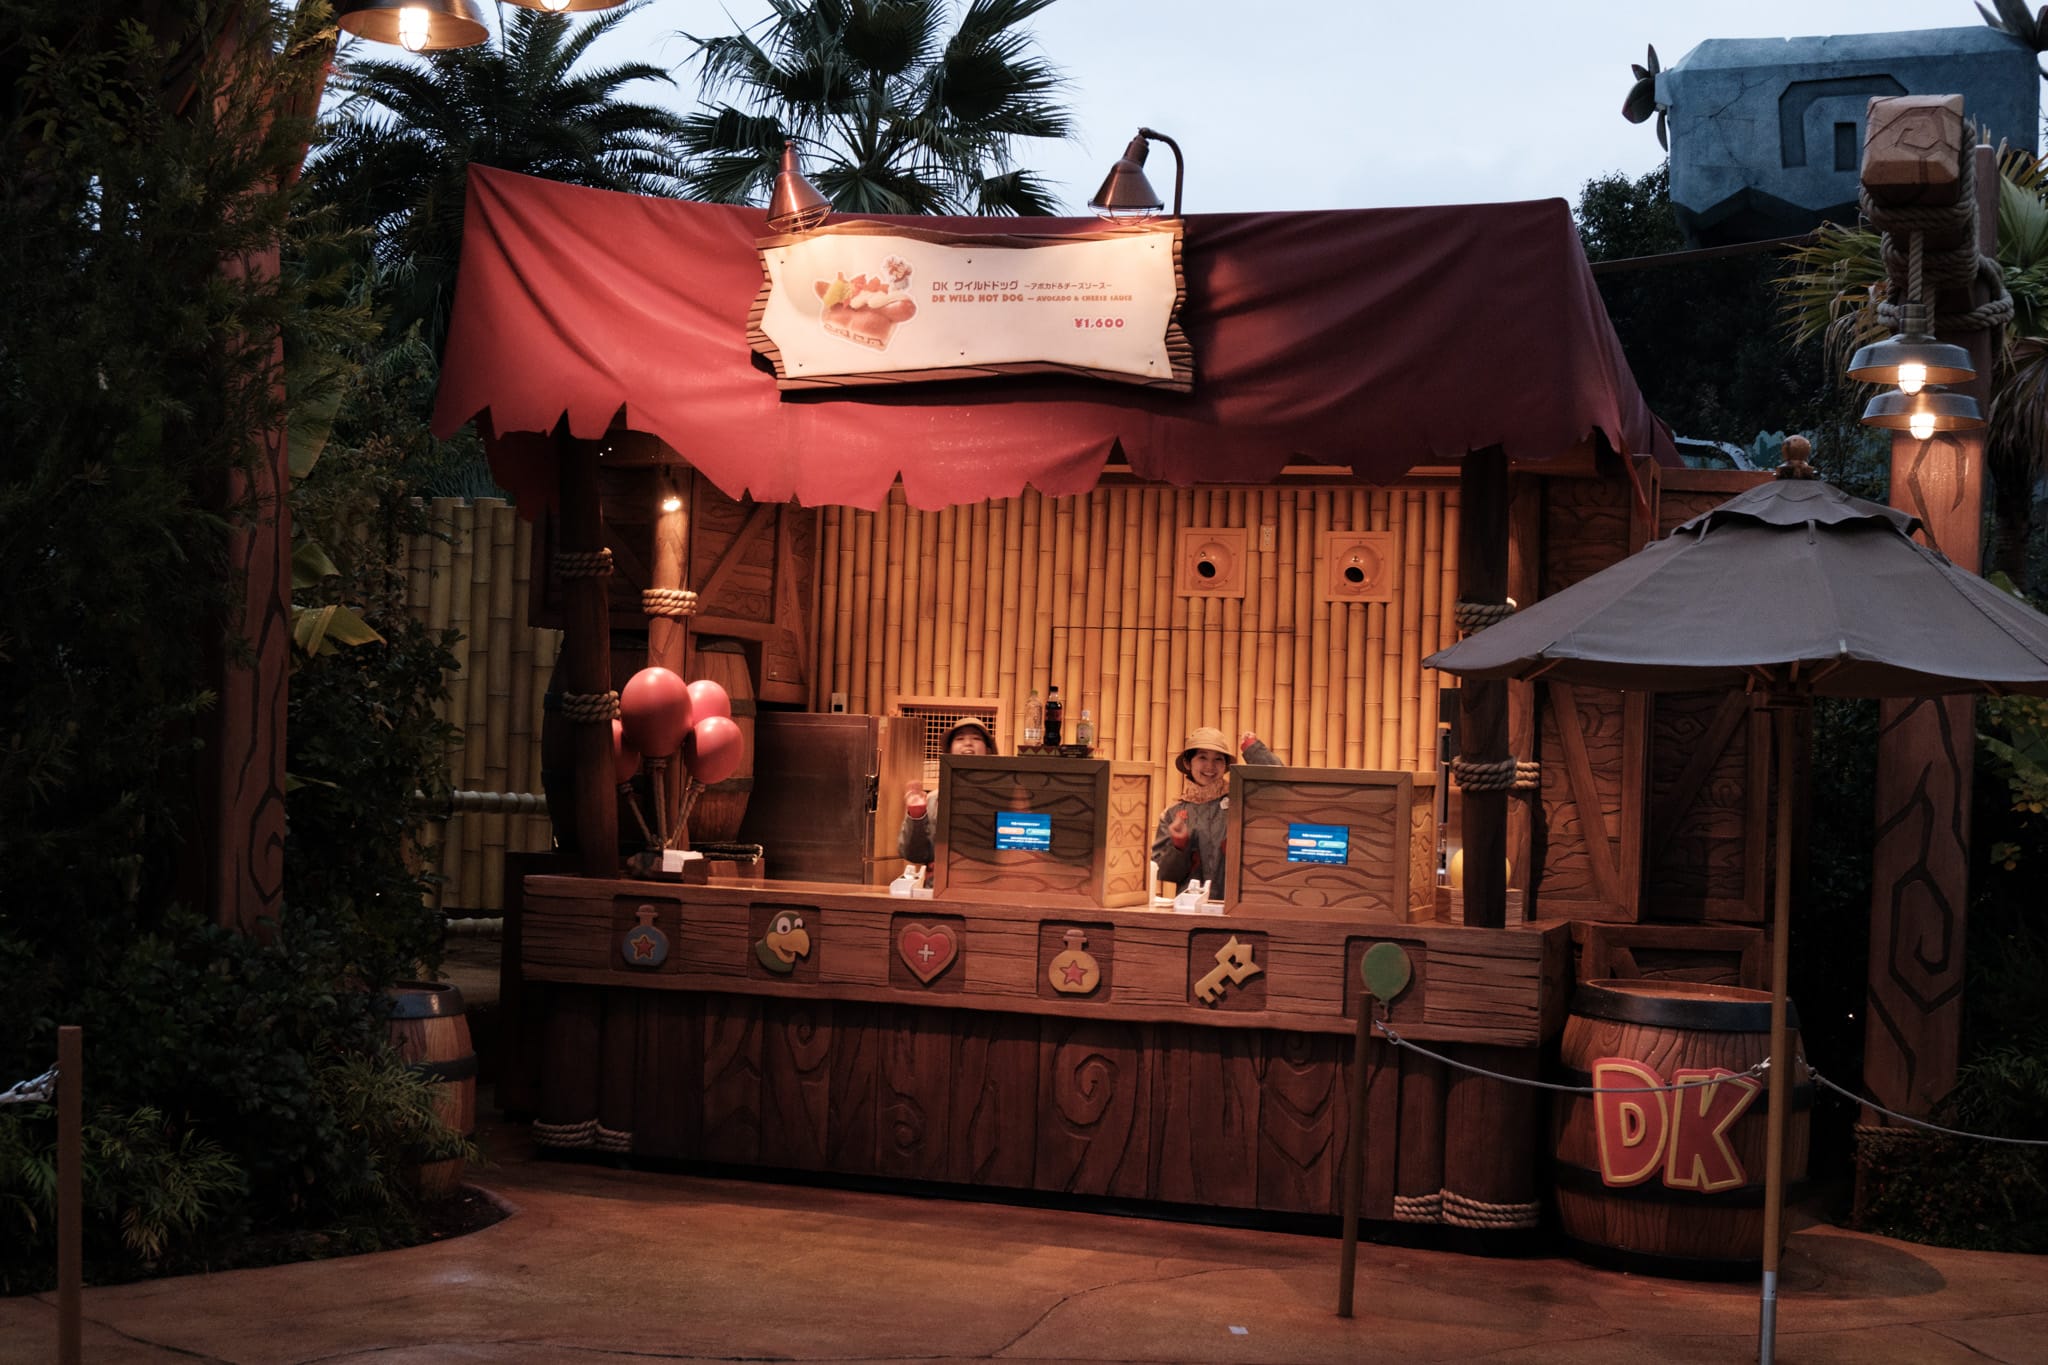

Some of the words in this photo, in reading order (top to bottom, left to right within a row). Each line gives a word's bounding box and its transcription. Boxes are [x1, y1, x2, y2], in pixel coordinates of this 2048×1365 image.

[932, 281, 948, 291] DK
[954, 280, 1019, 291] ワイルドドッグ
[932, 294, 946, 303] DK
[949, 294, 975, 303] WILD
[978, 294, 999, 303] HOT
[1002, 293, 1024, 302] DOG
[1074, 318, 1124, 329] ¥1,600
[1591, 1057, 1762, 1194] DK
